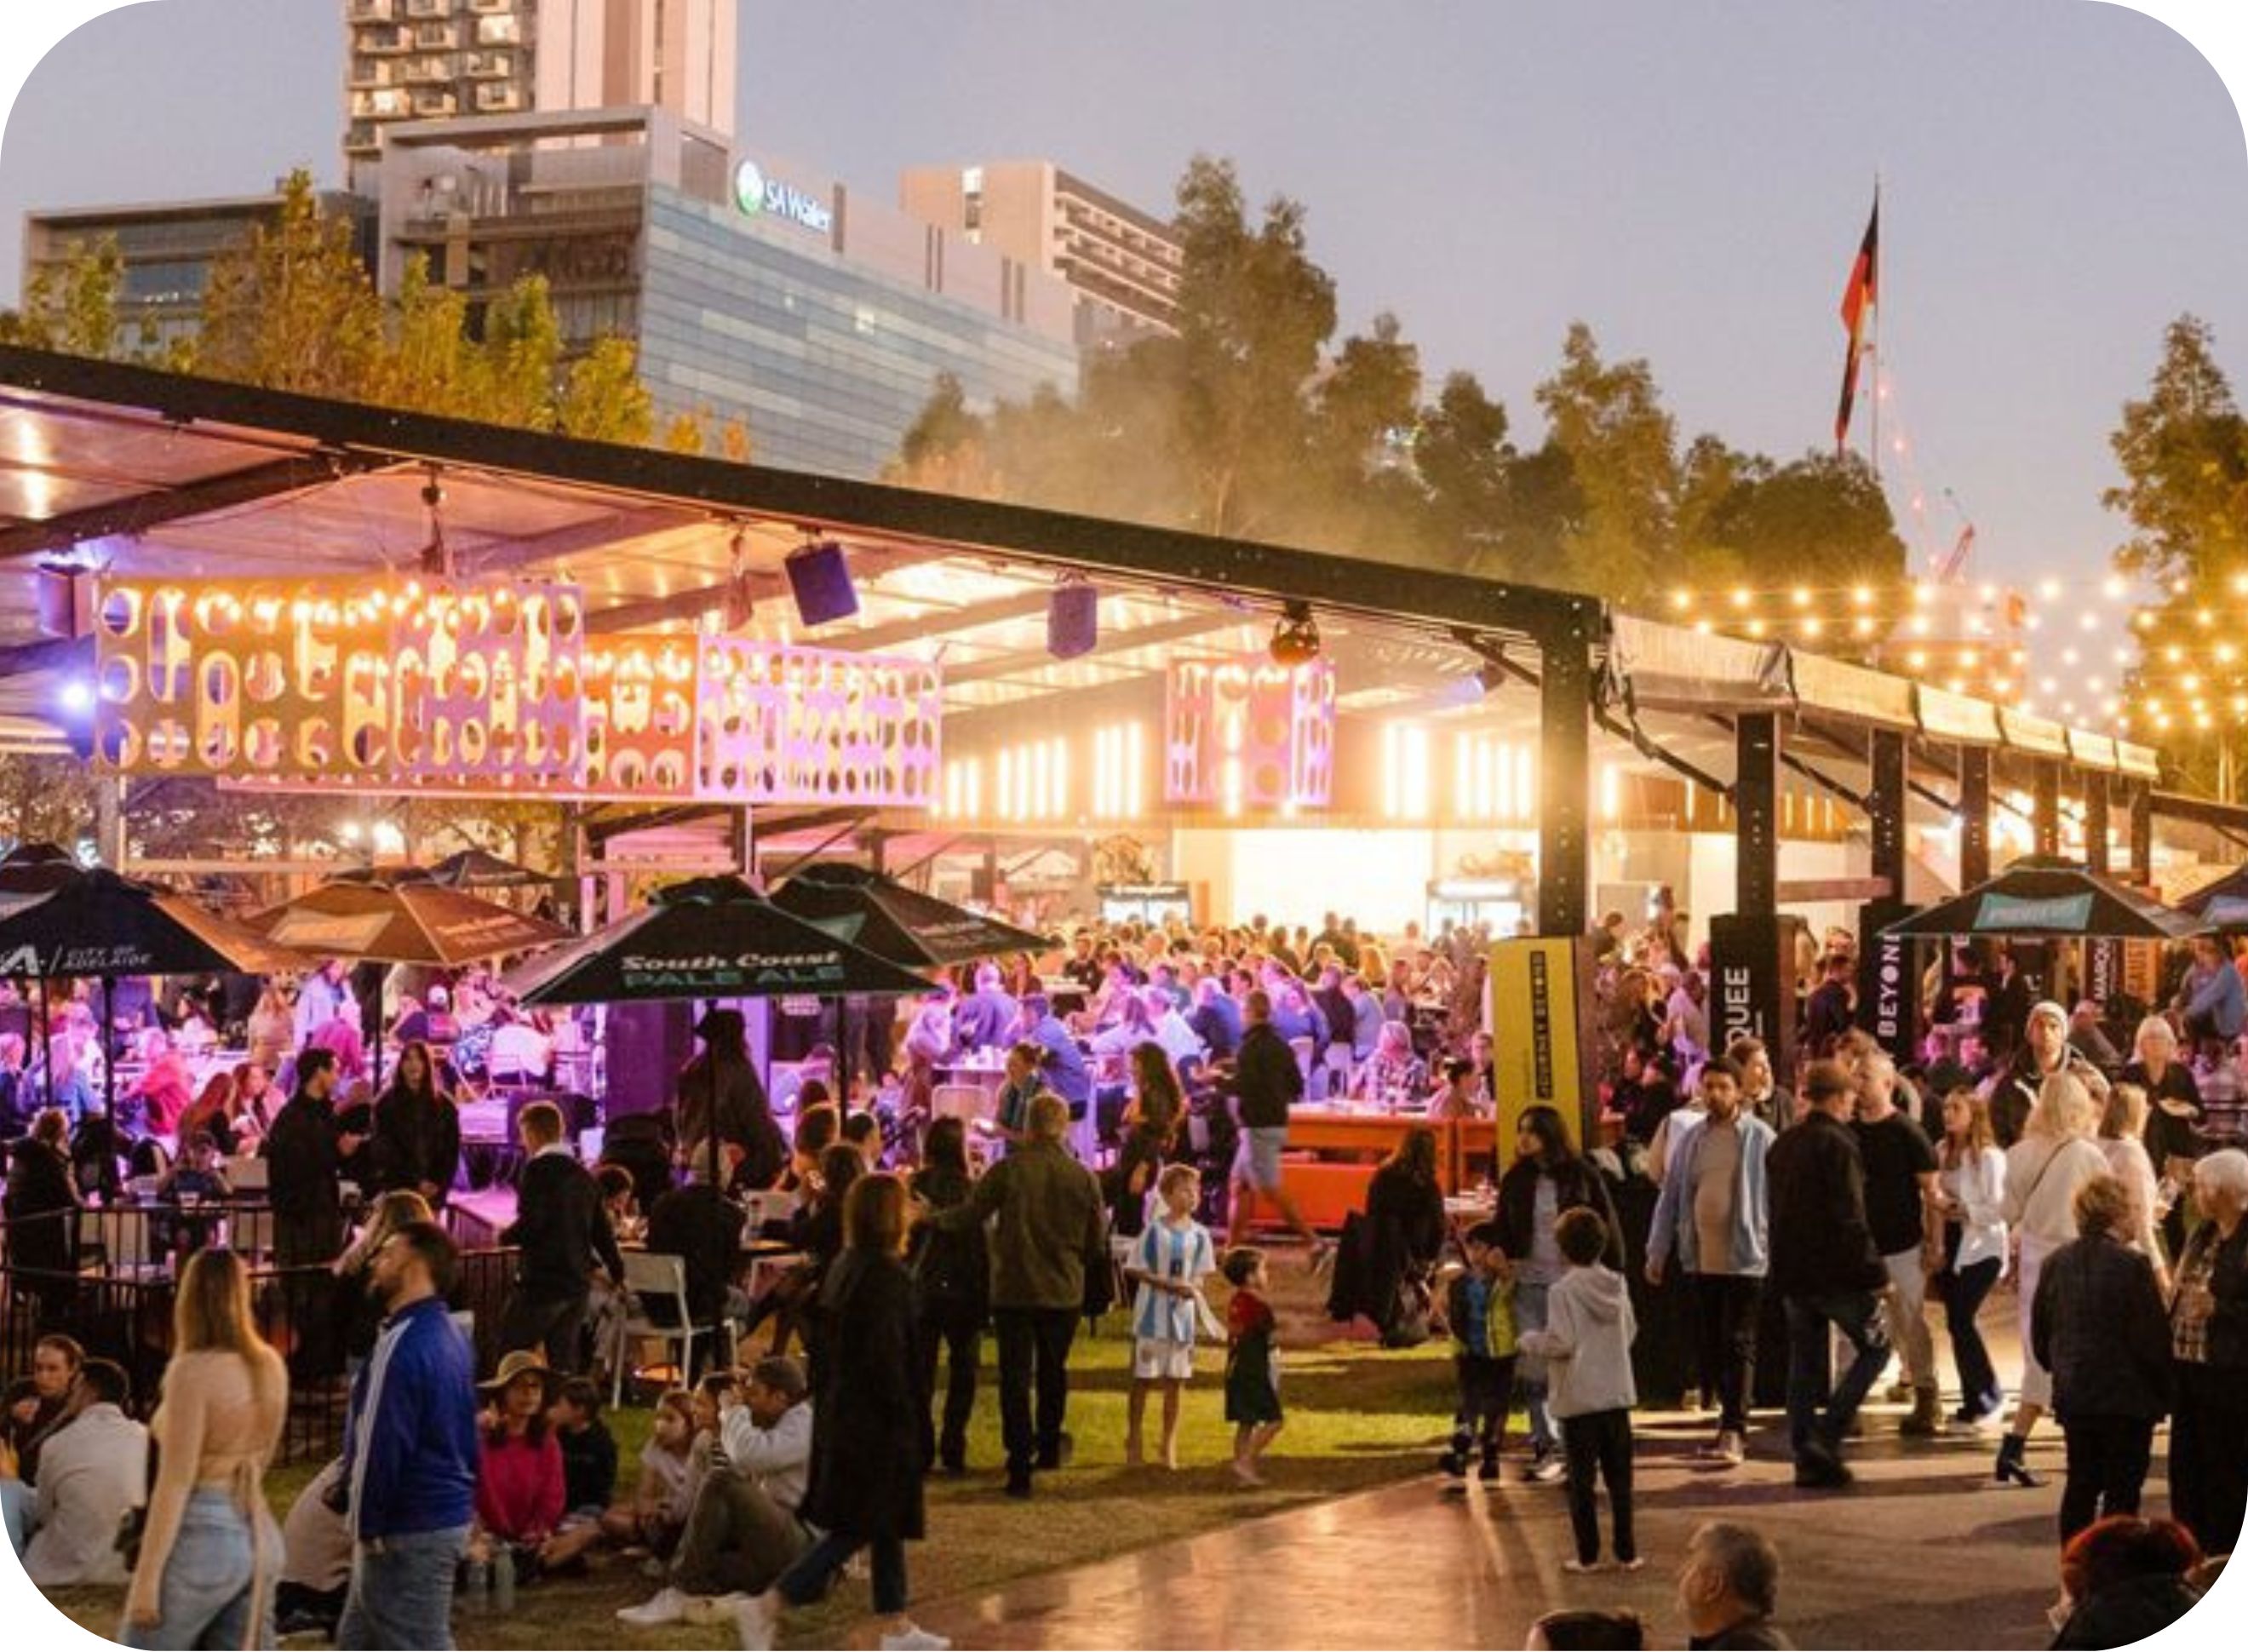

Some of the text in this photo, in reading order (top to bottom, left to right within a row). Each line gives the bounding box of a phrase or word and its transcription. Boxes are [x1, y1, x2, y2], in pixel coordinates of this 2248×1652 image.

[766, 179, 786, 216] SA
[62, 952, 152, 970] ADELAIDE
[621, 950, 840, 971] South Coast
[623, 965, 844, 987] PALE ALE
